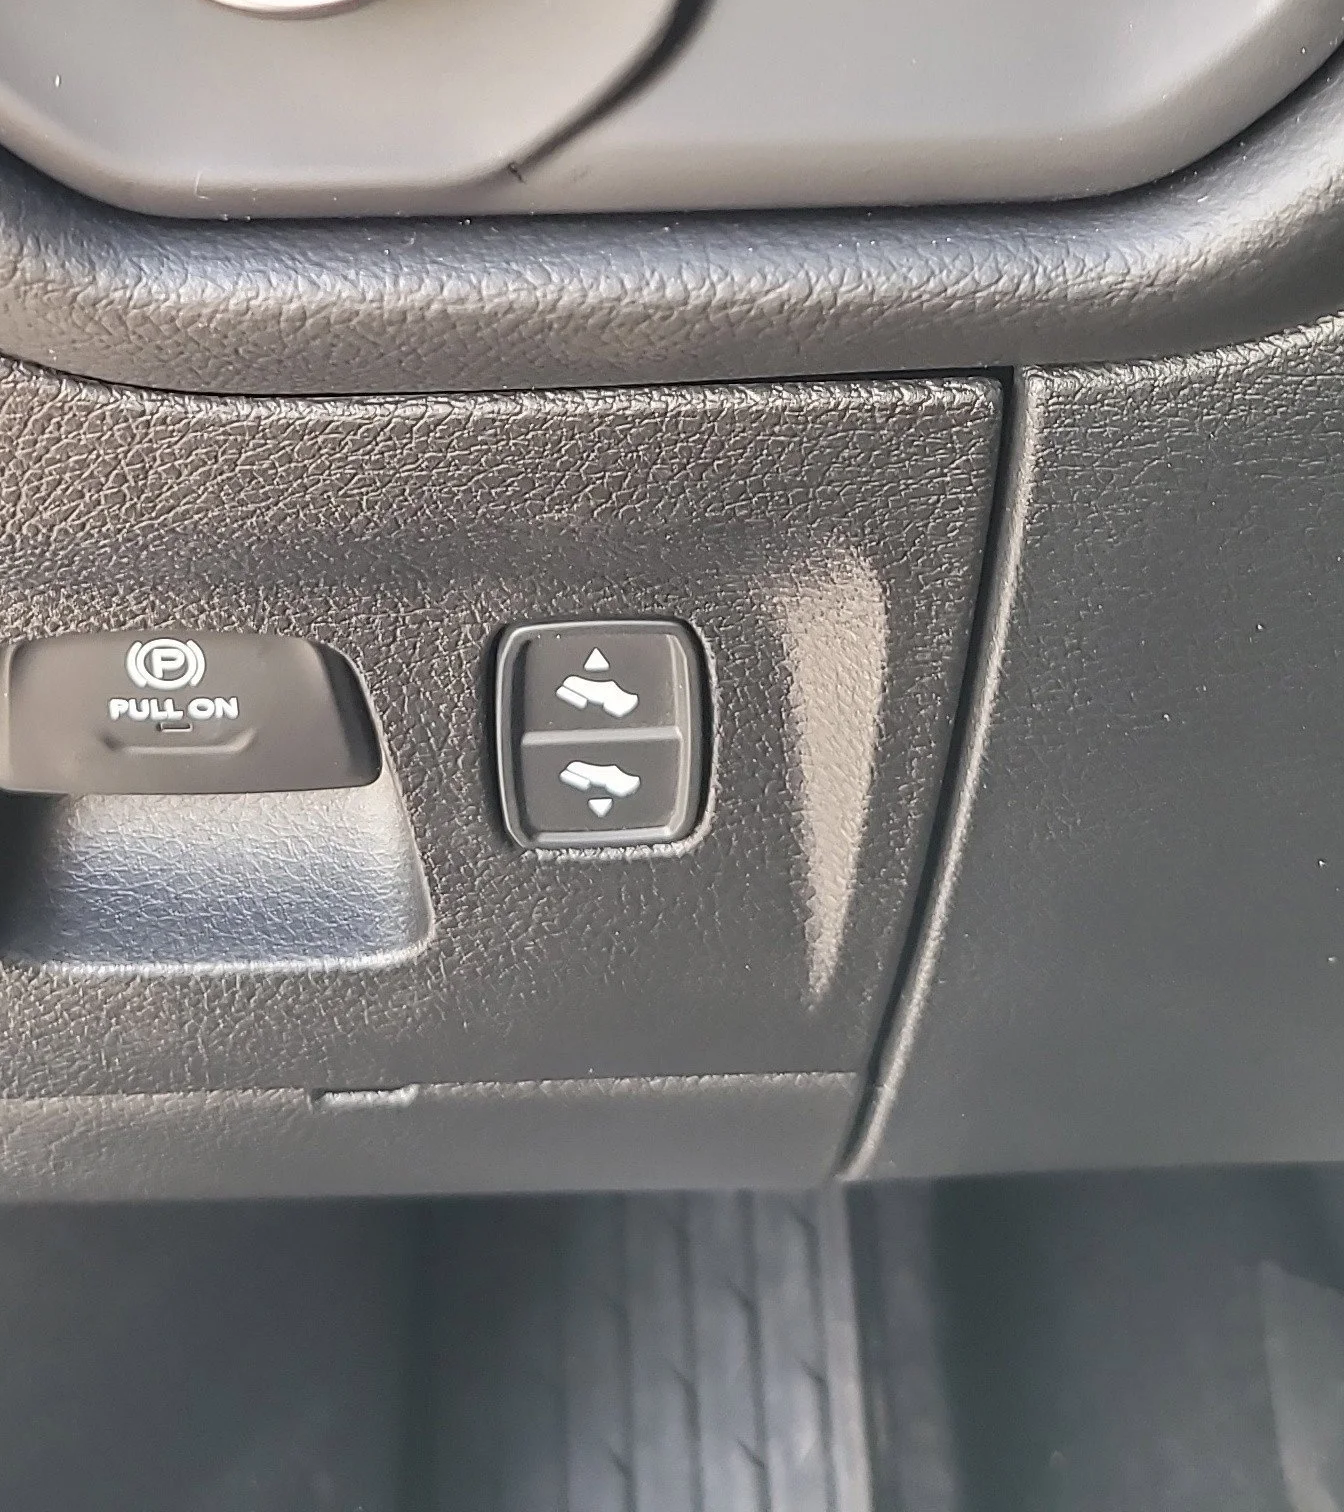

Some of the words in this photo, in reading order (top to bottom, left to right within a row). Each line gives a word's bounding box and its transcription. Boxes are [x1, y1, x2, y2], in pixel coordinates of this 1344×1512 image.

[152, 647, 187, 679] P
[109, 697, 184, 721] PULL
[187, 696, 239, 720] ON
